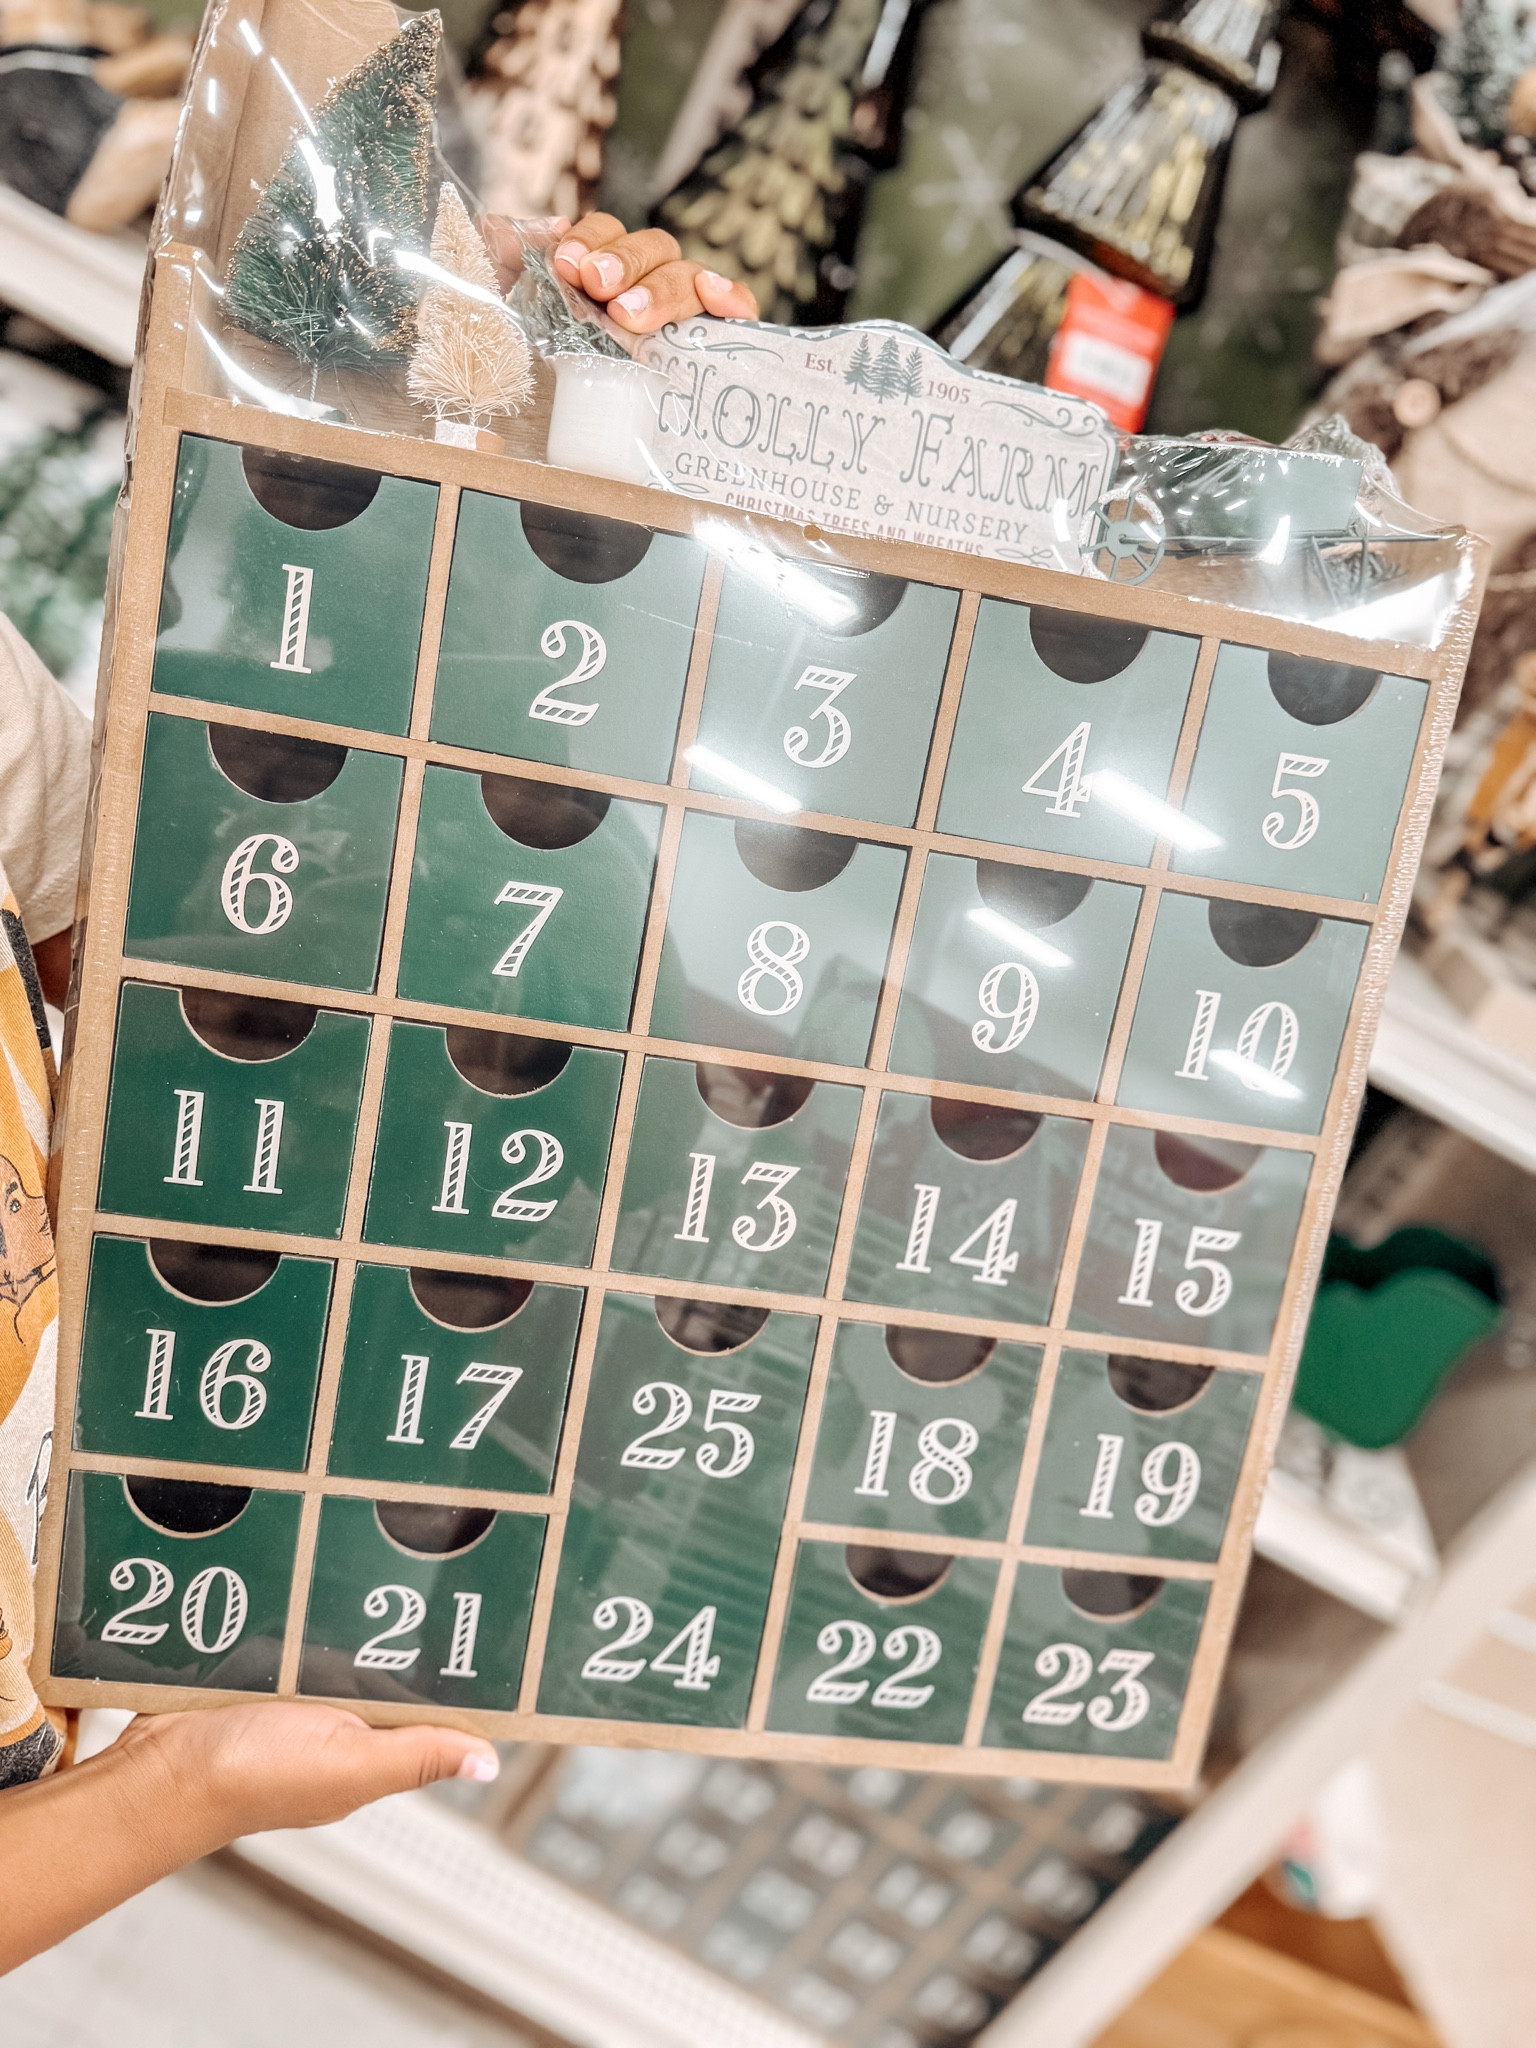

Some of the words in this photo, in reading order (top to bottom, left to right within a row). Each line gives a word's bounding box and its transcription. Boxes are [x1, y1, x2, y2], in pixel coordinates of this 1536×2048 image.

[804, 352, 838, 375] Est.
[926, 380, 971, 405] 1905
[652, 351, 887, 475] HOLLY
[900, 409, 1099, 519] FARM
[675, 452, 861, 511] GREENHOUSE
[874, 494, 894, 516] &
[906, 500, 1029, 545] NURSERY
[823, 511, 870, 534] TREES
[877, 522, 906, 541] AND
[913, 531, 984, 556] WREATHS
[270, 564, 315, 674] 1
[528, 620, 609, 728] 2
[783, 666, 857, 769] 3
[1021, 721, 1092, 818] 4
[1261, 753, 1330, 850] 5
[221, 833, 299, 934] 6
[492, 881, 564, 977] 7
[736, 922, 810, 1017] 8
[972, 962, 1039, 1054] 9
[1175, 989, 1300, 1092] 10
[164, 1090, 285, 1195] 11
[432, 1121, 565, 1222] 12
[674, 1153, 800, 1252] 13
[896, 1184, 1018, 1286] 14
[1118, 1218, 1242, 1318] 15
[134, 1329, 272, 1430] 16
[386, 1355, 523, 1450] 17
[621, 1382, 762, 1479] 25
[854, 1410, 979, 1506] 18
[1079, 1434, 1201, 1527] 19
[101, 1557, 248, 1654] 20
[354, 1584, 482, 1678] 21
[581, 1596, 720, 1691] 24
[806, 1619, 942, 1709] 22
[1022, 1643, 1154, 1732] 23
